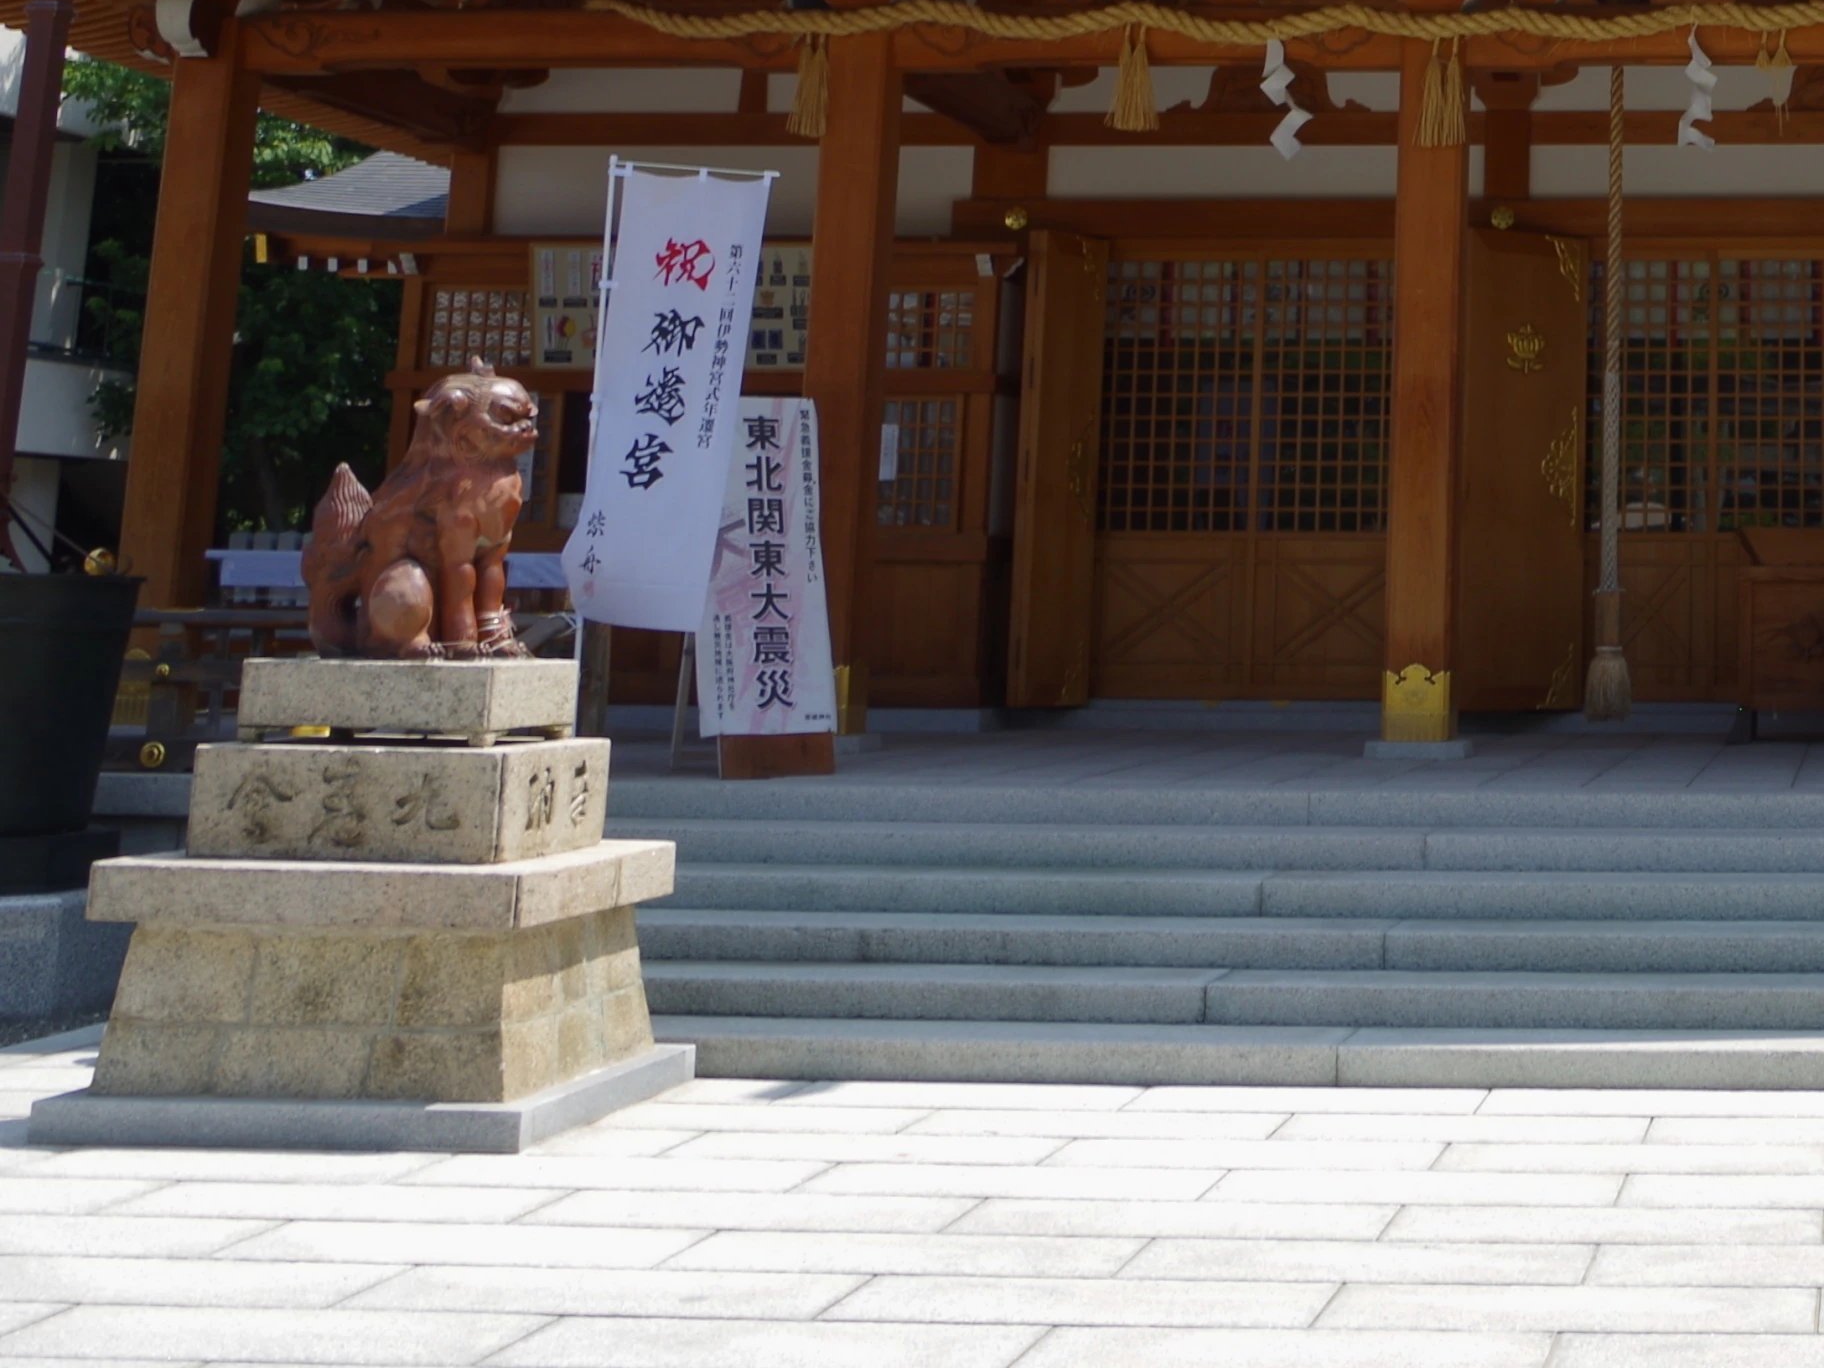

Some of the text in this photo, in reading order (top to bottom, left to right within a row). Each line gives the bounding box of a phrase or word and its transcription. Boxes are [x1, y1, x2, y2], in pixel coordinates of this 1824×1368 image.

[743, 415, 795, 711] 東北関東大震災
